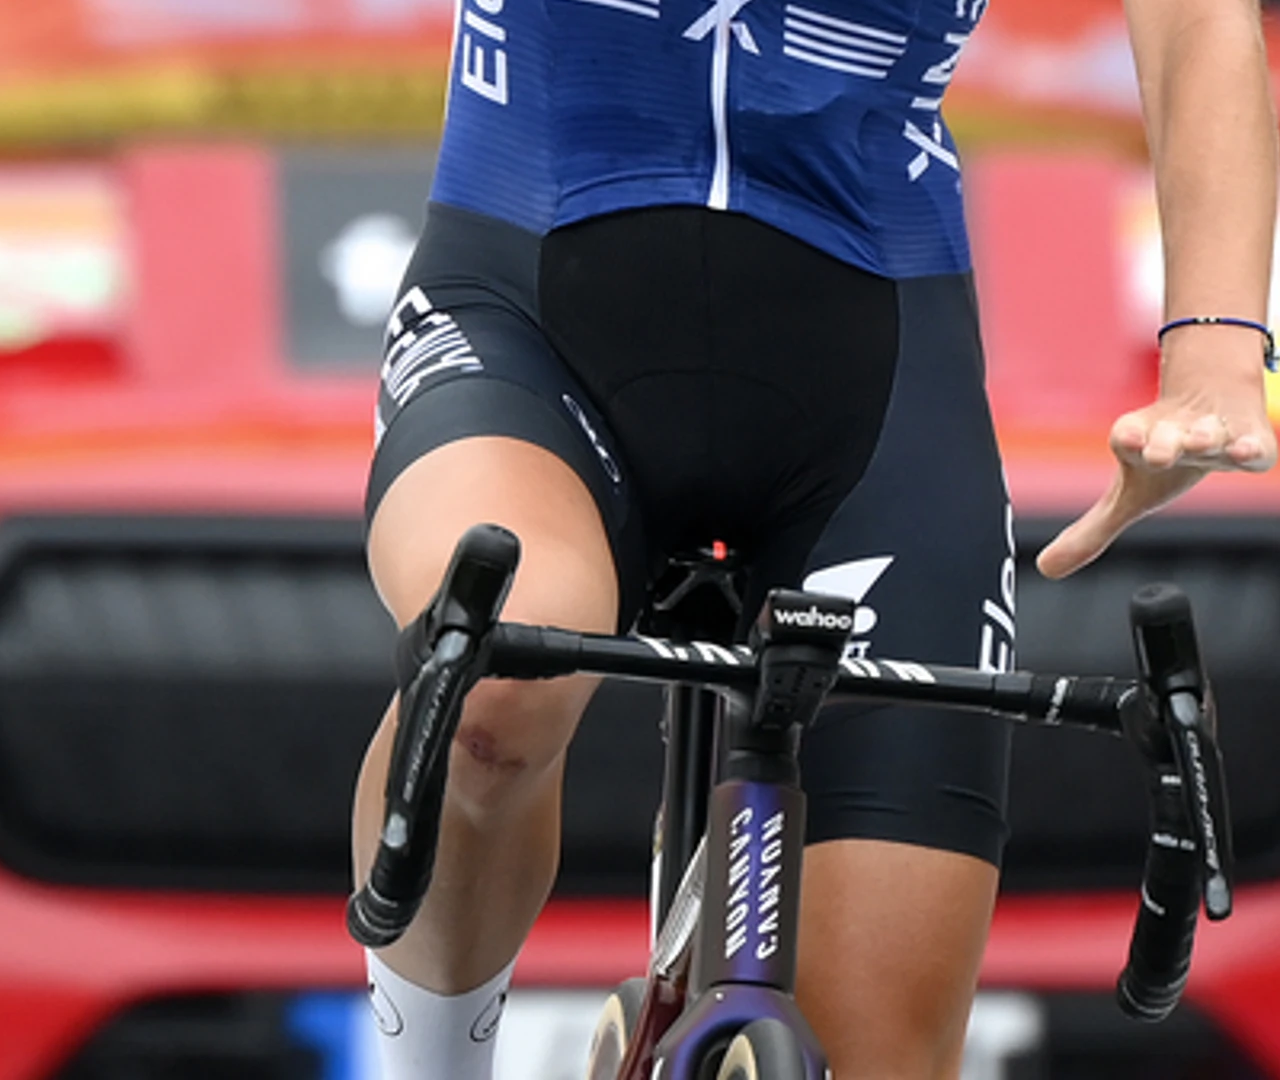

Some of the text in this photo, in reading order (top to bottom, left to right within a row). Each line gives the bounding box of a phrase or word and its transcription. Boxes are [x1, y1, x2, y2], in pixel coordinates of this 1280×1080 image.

[773, 605, 853, 631] wahoo
[725, 806, 754, 960] CANYON
[756, 810, 786, 961] CANYON
